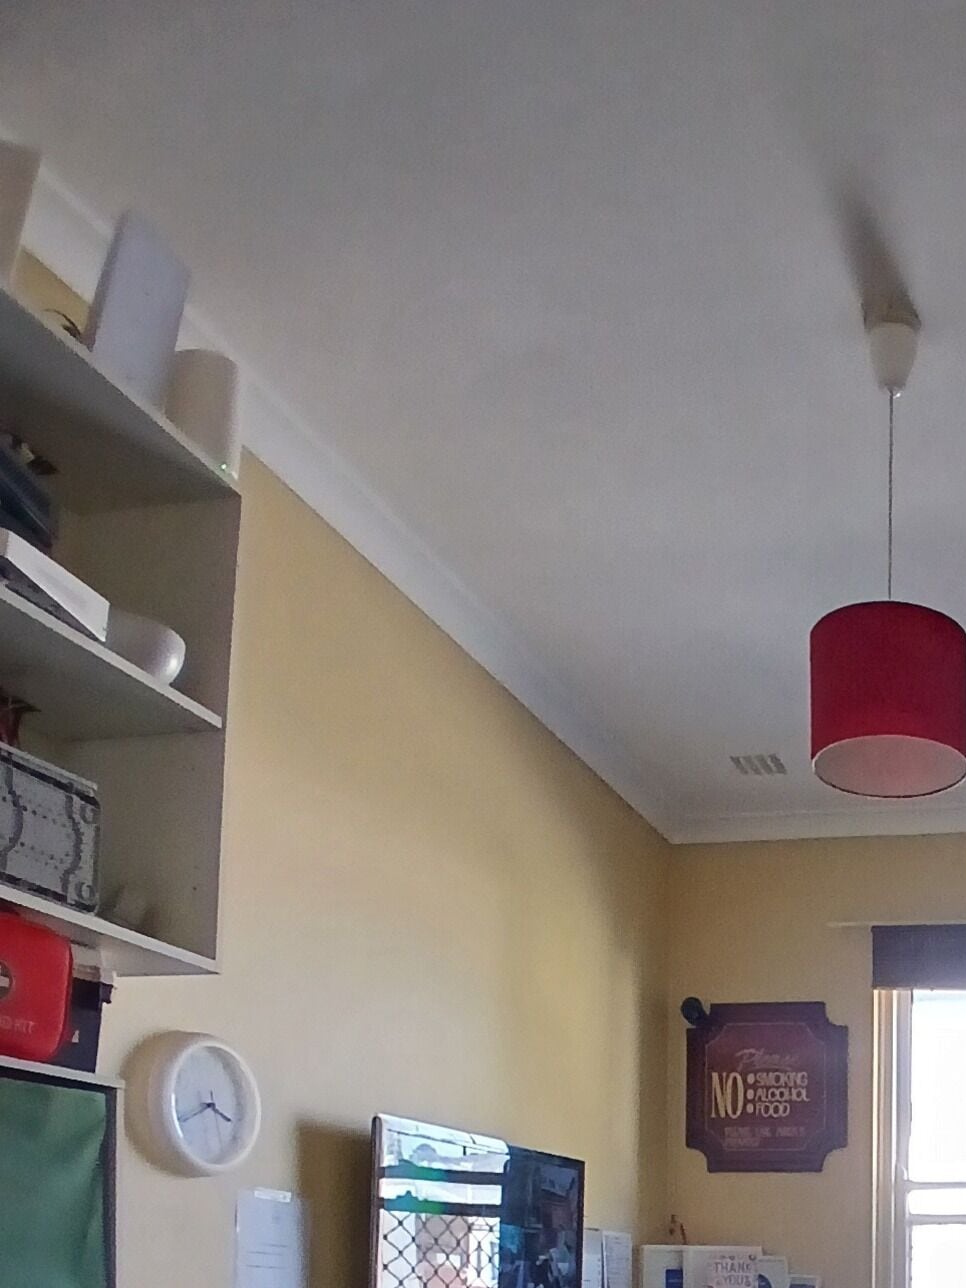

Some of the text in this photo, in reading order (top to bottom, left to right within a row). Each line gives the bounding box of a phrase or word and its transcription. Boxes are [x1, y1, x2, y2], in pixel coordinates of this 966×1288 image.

[756, 1072, 808, 1086] SMOKING
[711, 1072, 744, 1119] NO
[755, 1088, 811, 1102] ALCOHOL
[756, 1103, 790, 1117] FOOD
[714, 1262, 752, 1274] THANK
